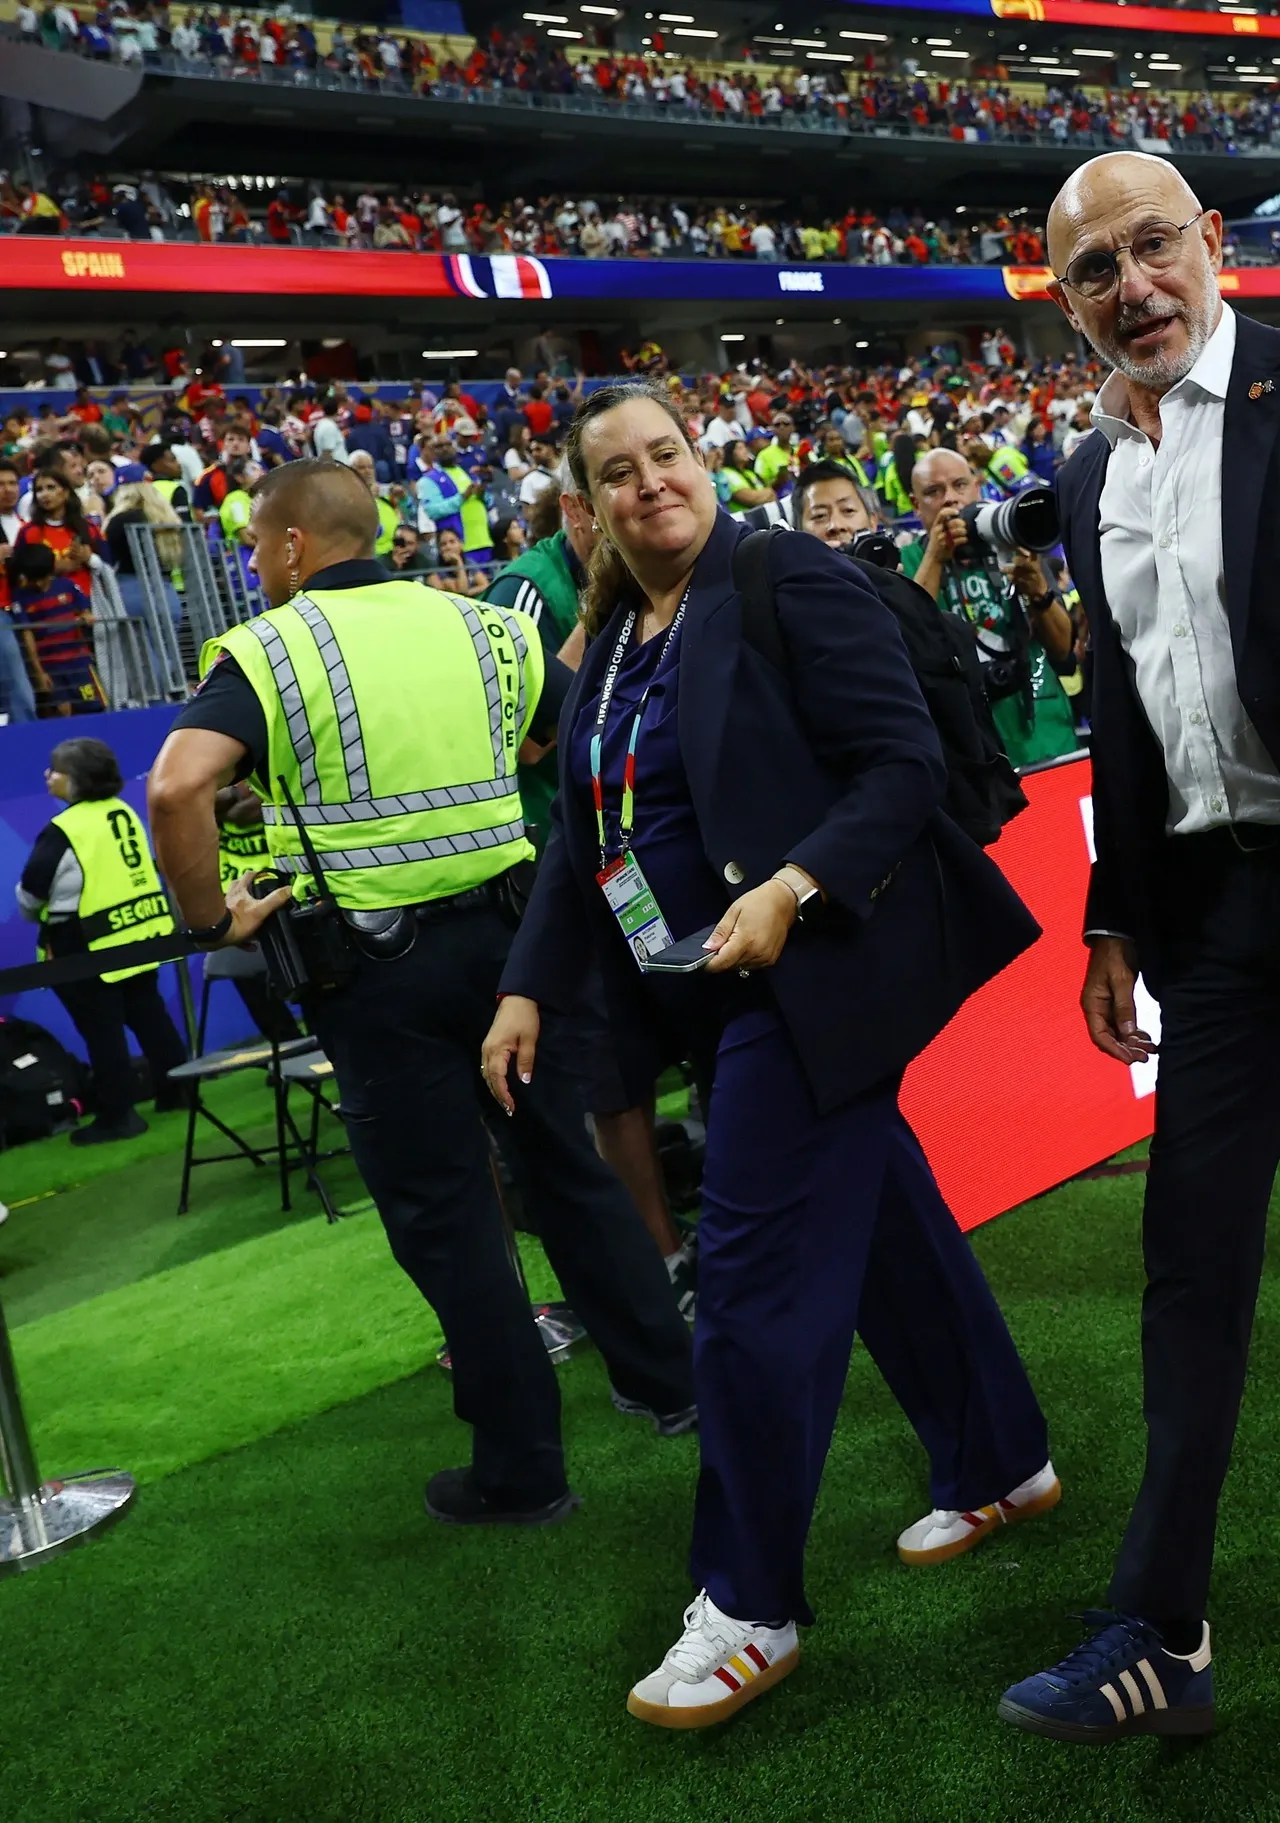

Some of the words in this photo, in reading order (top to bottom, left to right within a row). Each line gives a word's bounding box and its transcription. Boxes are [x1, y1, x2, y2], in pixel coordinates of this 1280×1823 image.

[61, 250, 125, 278] SPAIN
[619, 610, 636, 645] 2026
[612, 644, 624, 664] CUP
[475, 604, 514, 748] POLICE
[601, 664, 618, 702] WORLD
[596, 701, 609, 725] FIFA
